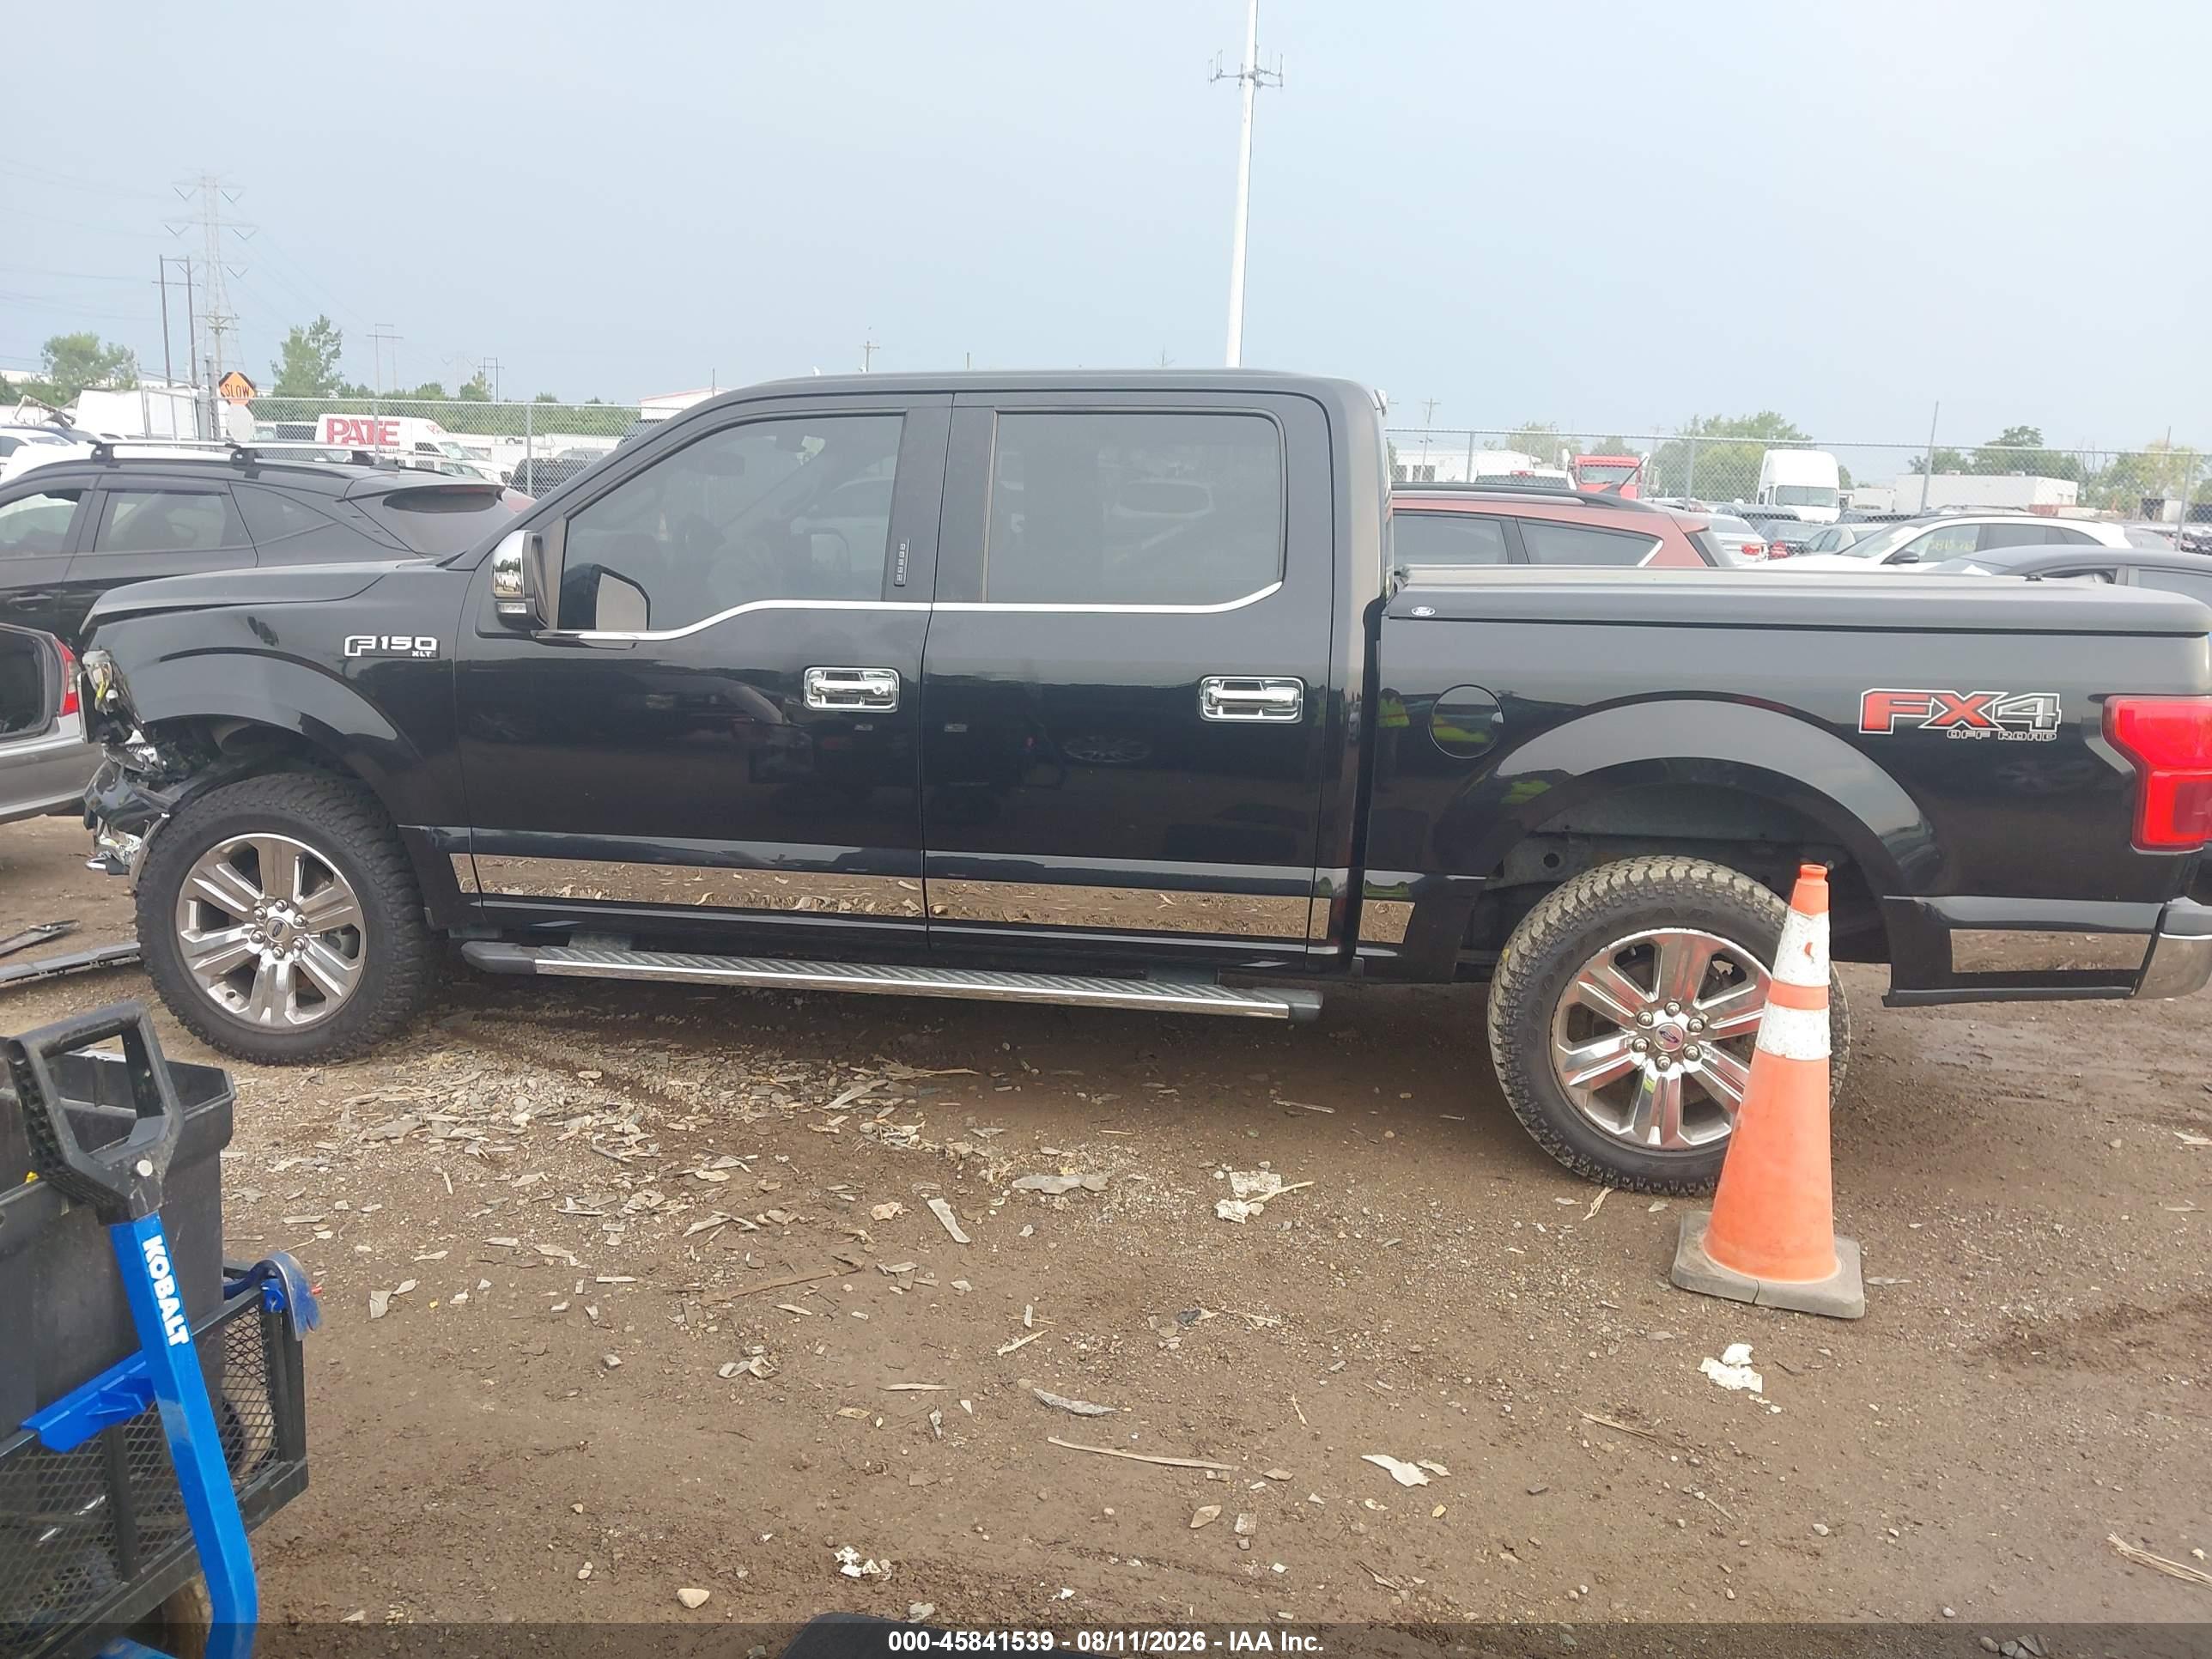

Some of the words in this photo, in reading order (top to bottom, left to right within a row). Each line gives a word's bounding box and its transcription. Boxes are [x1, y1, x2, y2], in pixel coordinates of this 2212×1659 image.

[225, 384, 250, 398] SLOW
[326, 418, 400, 446] PATE
[1859, 688, 2061, 734] FX4
[1947, 730, 1991, 741] OFF
[1998, 730, 2057, 742] ROAD
[142, 1235, 190, 1346] KOBALT
